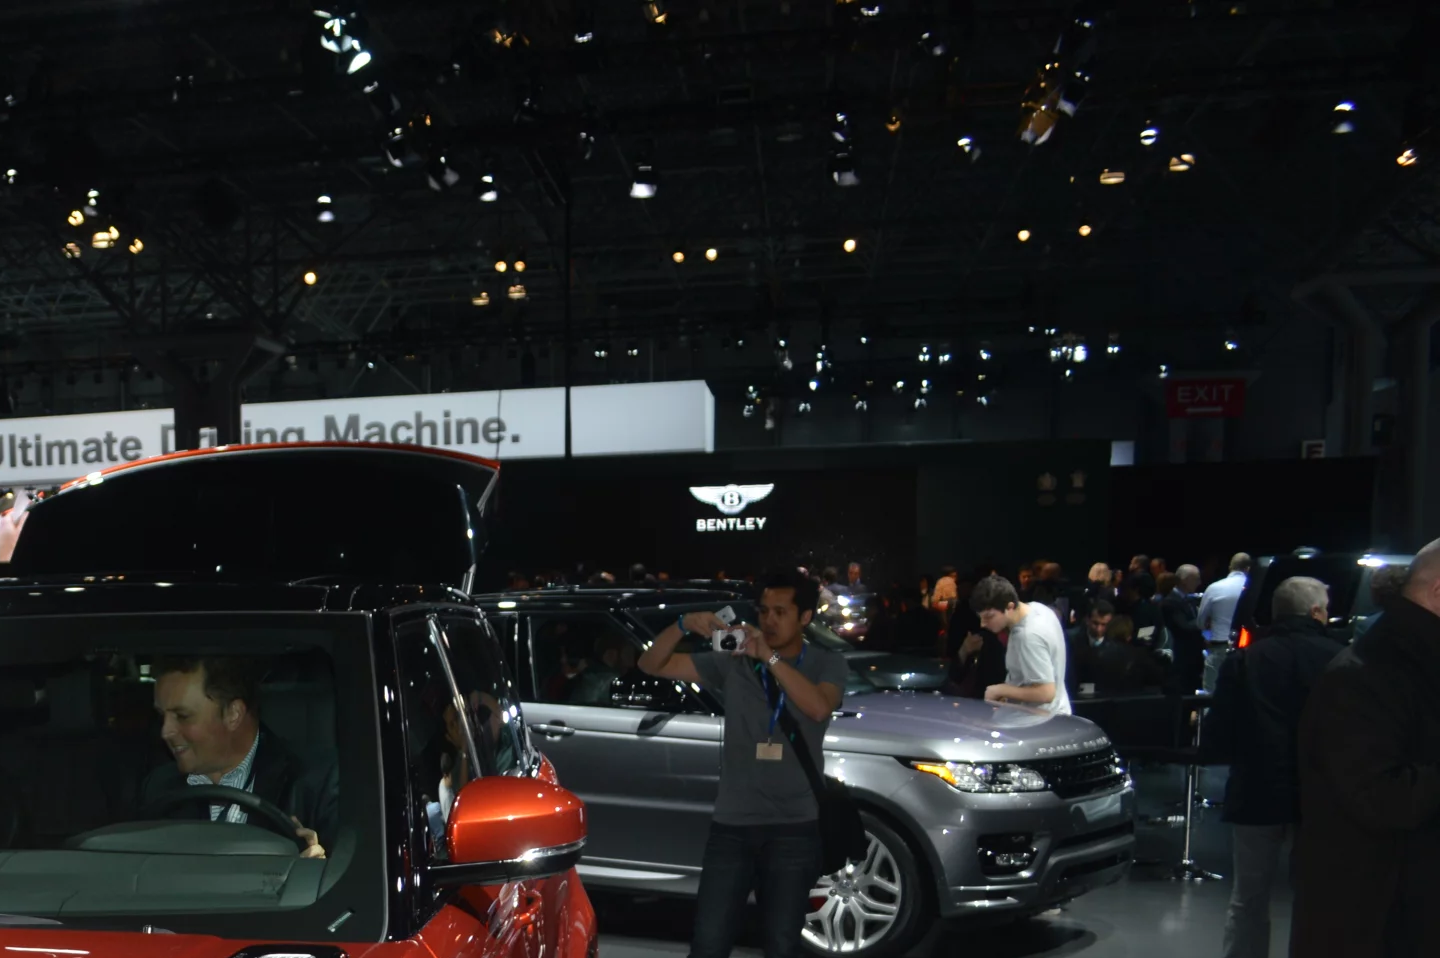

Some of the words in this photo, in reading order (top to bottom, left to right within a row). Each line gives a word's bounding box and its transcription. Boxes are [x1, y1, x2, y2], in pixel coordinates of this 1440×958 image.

[1177, 384, 1235, 403] EXIT
[324, 410, 520, 446] Machine.
[696, 517, 767, 532] BENTLEY
